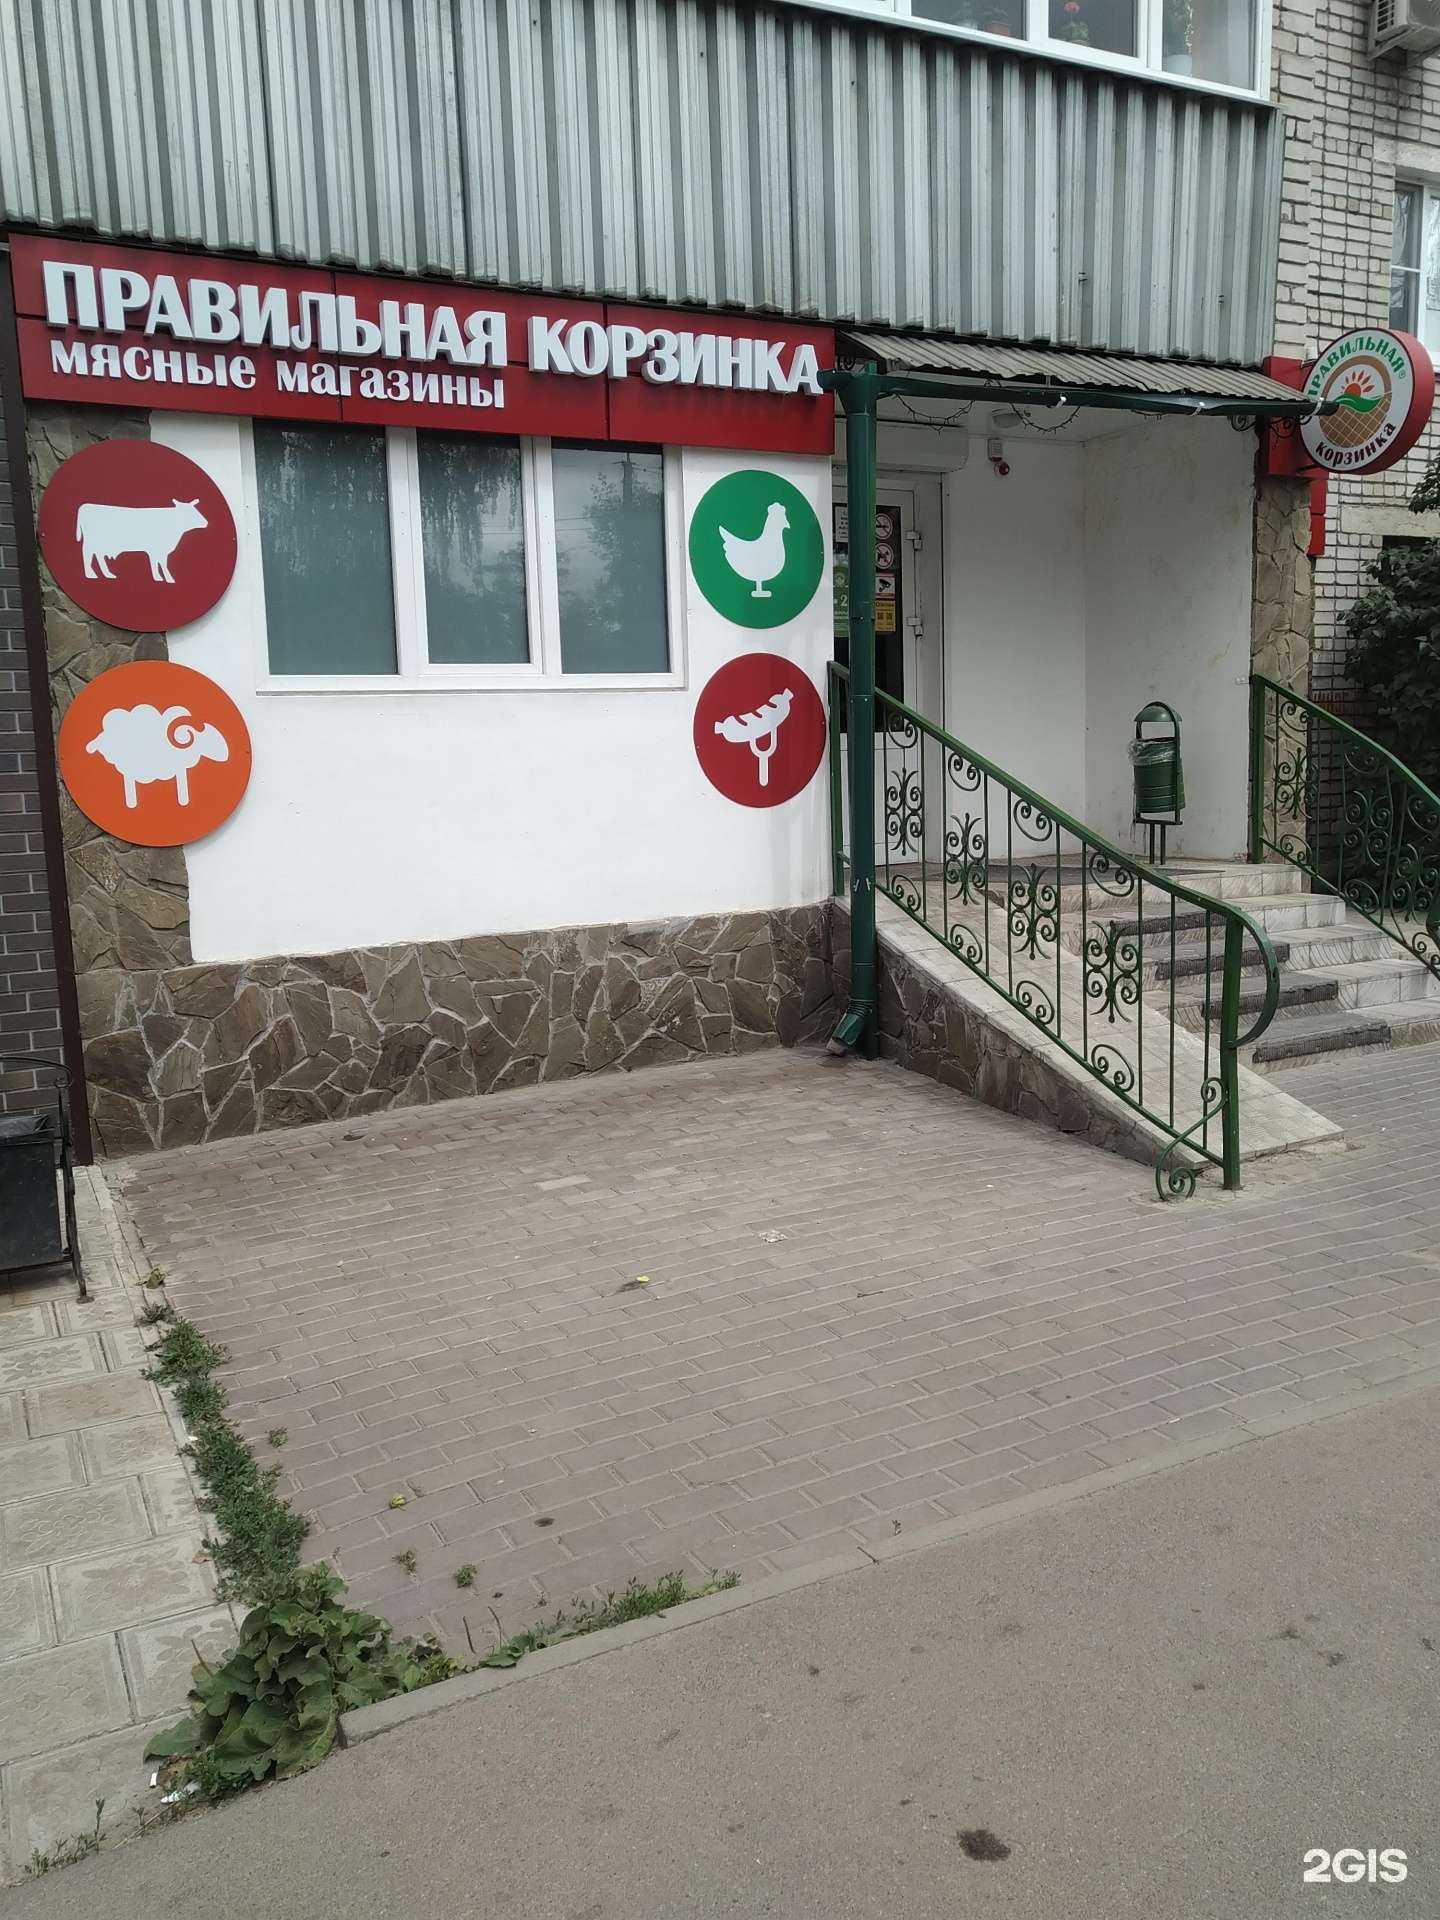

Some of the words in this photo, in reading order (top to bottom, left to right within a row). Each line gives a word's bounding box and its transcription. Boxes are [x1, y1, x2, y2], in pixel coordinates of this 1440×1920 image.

[42, 261, 507, 367] ПРАВИЛЬНАЯ
[527, 315, 823, 396] КОРЗИНКА
[50, 339, 256, 389] мясные
[277, 360, 504, 409] магазины
